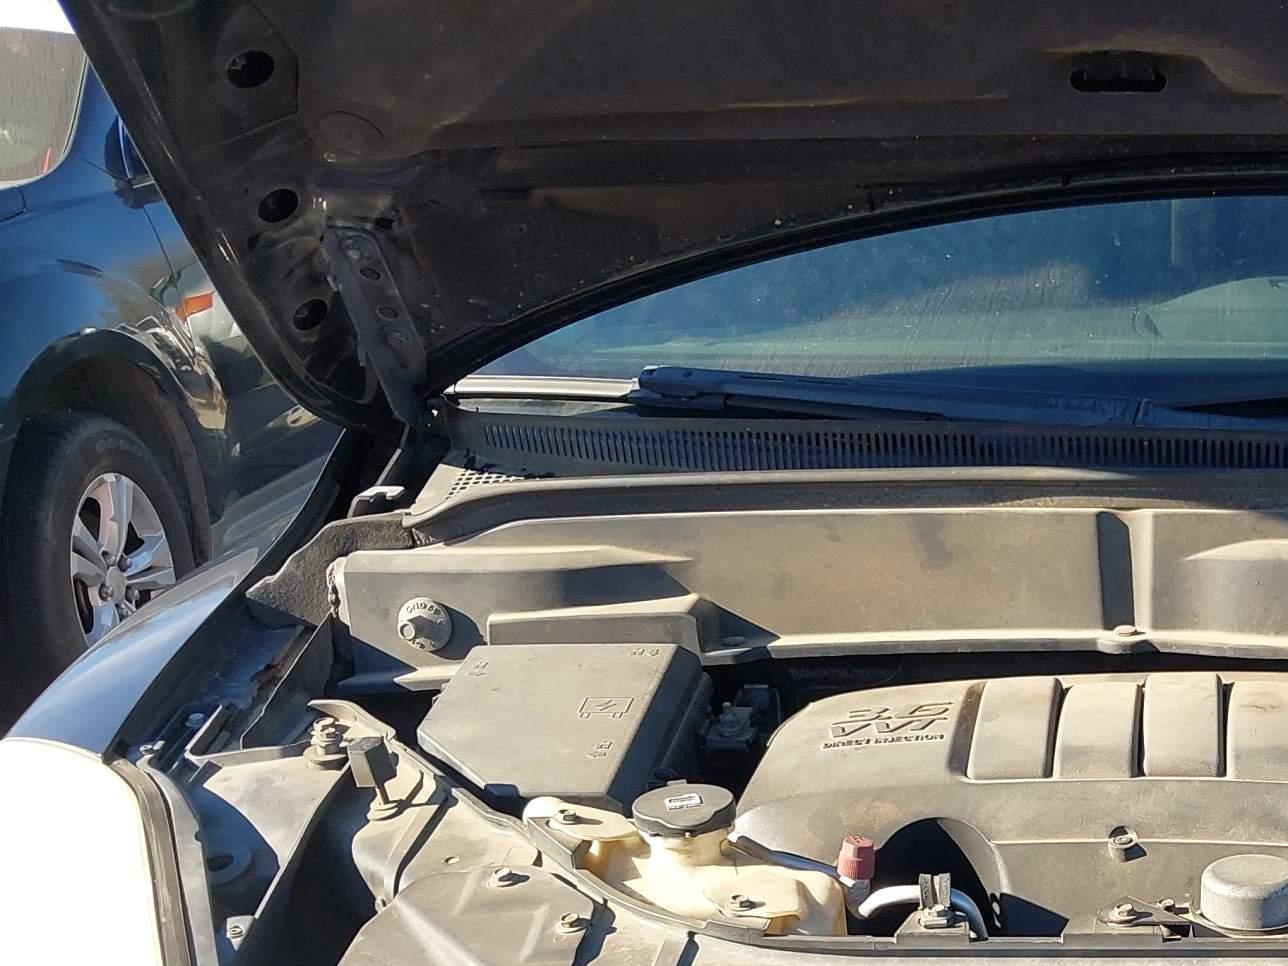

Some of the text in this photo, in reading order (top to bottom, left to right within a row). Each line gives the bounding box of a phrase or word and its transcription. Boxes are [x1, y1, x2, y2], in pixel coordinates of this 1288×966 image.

[831, 701, 954, 726] 3.6
[829, 716, 949, 739] VVT
[821, 732, 946, 750] DIRECT INJECTION
